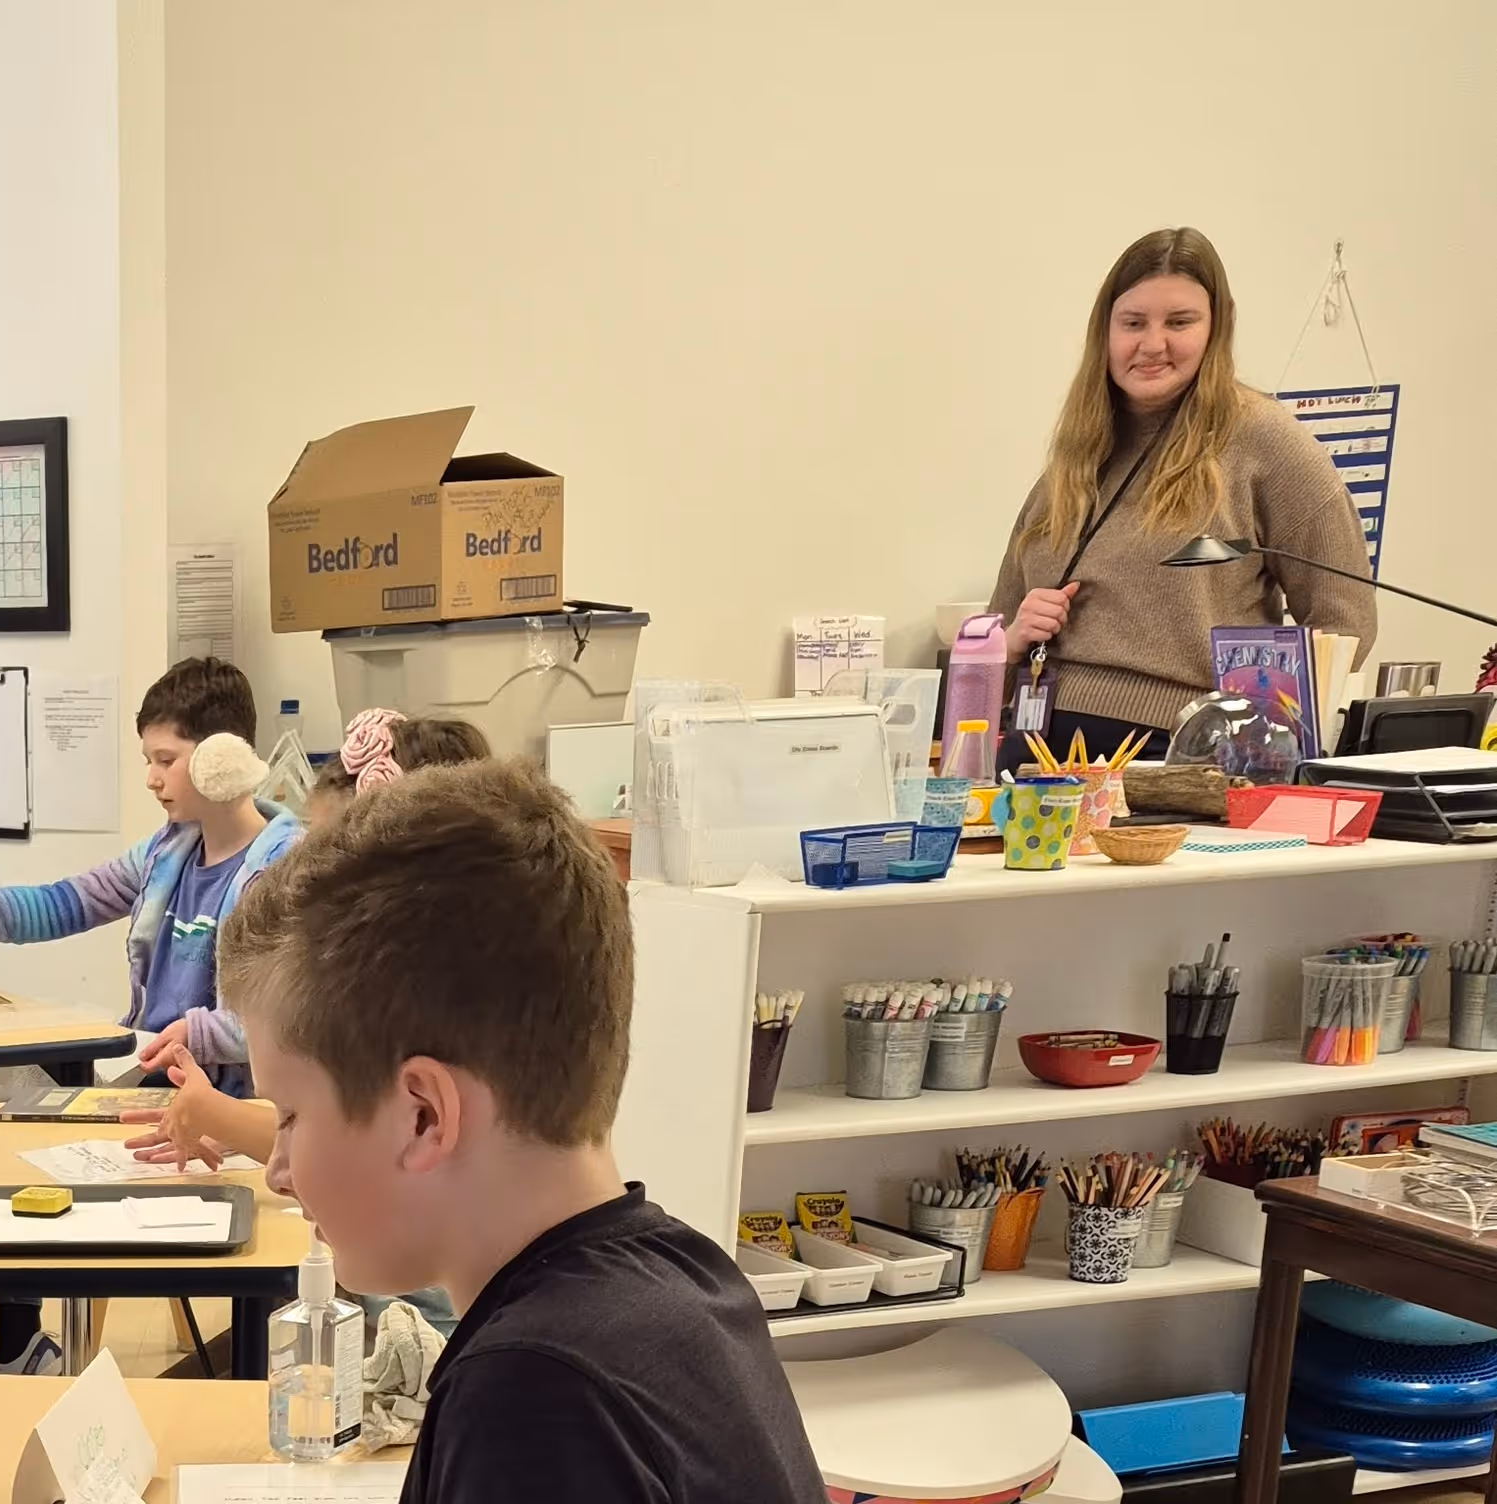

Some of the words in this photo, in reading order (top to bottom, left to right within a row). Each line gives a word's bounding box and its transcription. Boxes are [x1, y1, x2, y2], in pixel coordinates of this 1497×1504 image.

[308, 532, 399, 574] Bedford
[465, 526, 542, 558] Bedford
[853, 630, 871, 640] Wed
[1215, 646, 1301, 676] CHEMISTRY
